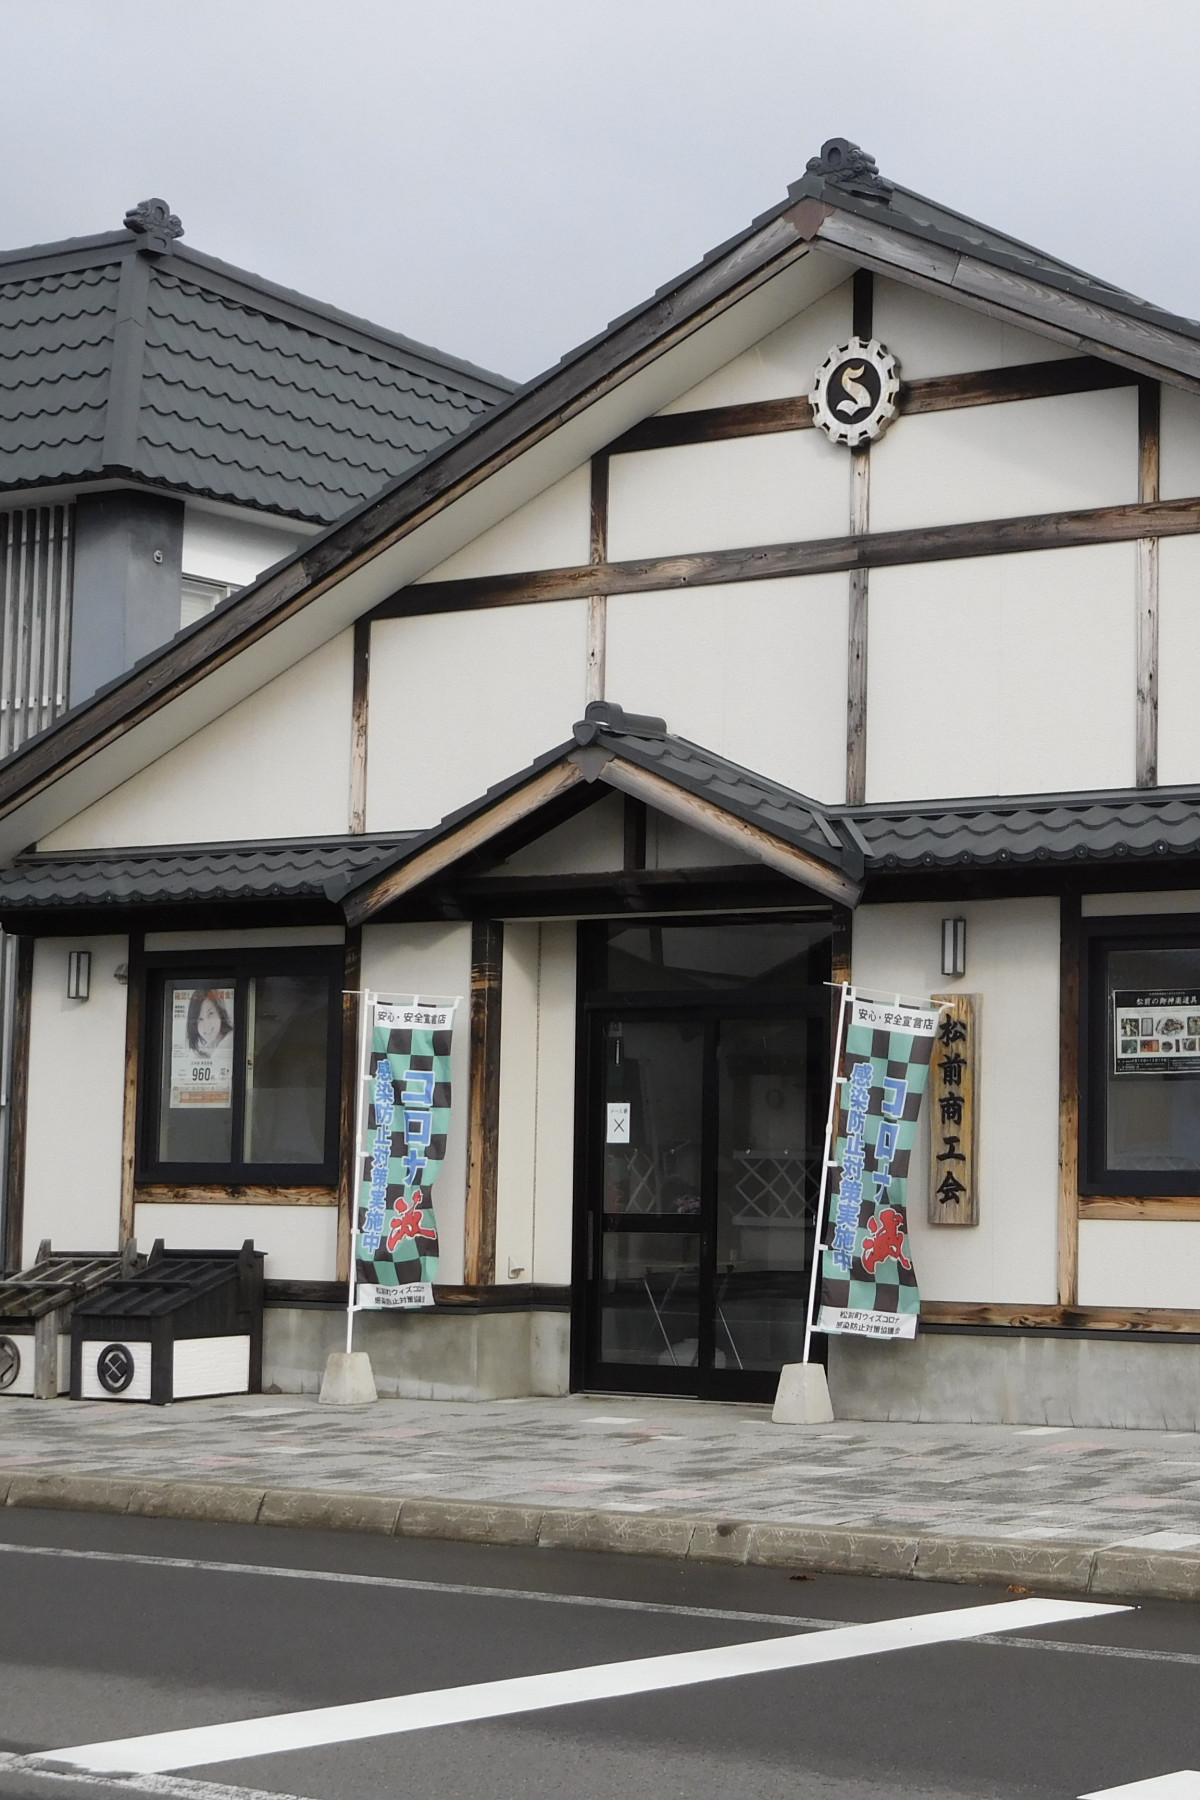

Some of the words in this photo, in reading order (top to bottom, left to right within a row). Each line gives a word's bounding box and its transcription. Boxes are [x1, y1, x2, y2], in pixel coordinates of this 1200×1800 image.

[377, 1011, 448, 1025] 安心・安全宣言店
[858, 1008, 935, 1031] 安心・安全宣言店
[936, 1013, 968, 1205] 松前商工会
[362, 1059, 395, 1254] 感染防止対策実施中
[832, 1062, 872, 1273] 感染防止対策実施中
